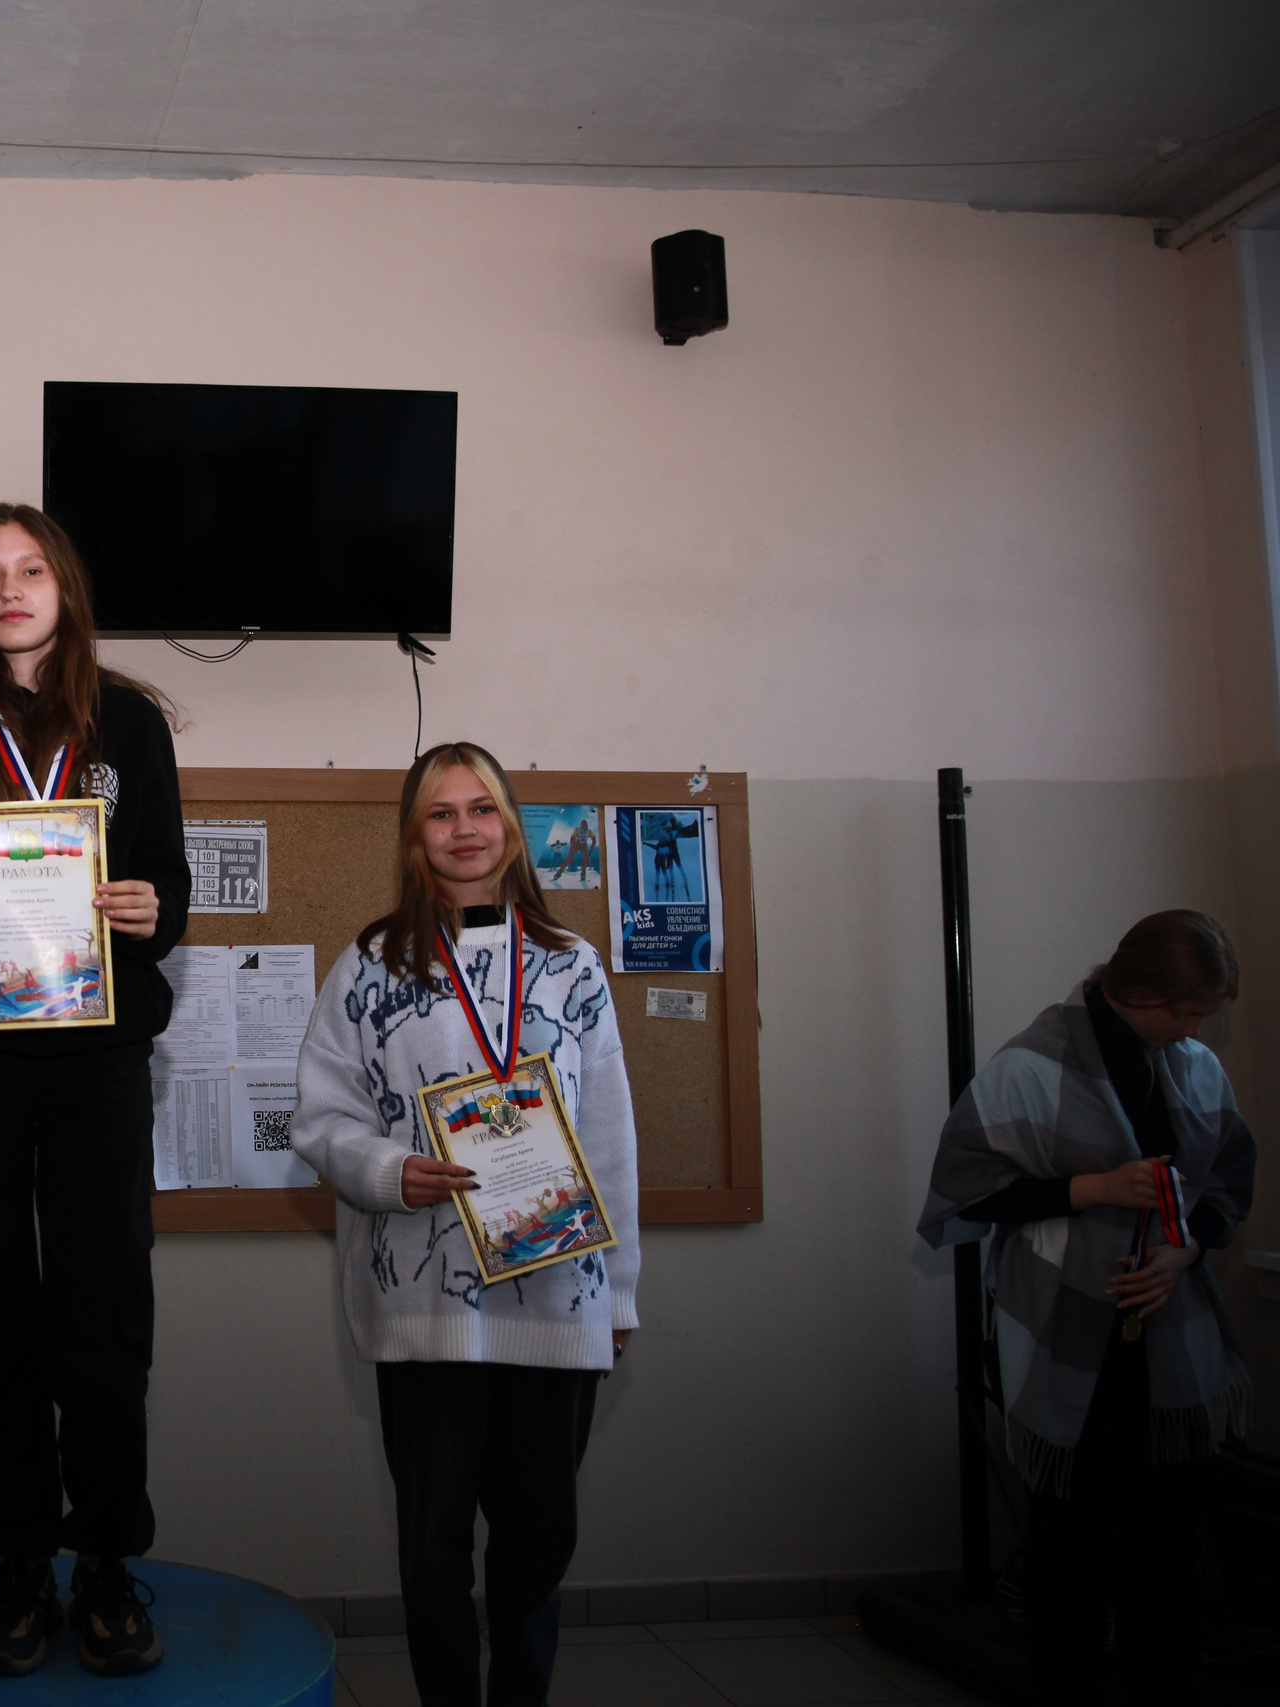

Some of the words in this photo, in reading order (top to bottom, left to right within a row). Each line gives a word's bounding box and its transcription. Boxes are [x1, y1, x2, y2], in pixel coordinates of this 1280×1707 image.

[202, 852, 215, 861] 101
[202, 866, 216, 874] 102
[202, 880, 215, 888] 103
[222, 878, 256, 905] 112
[202, 894, 215, 902] 104
[666, 907, 706, 915] СОВМЕСТНОЕ
[623, 908, 652, 925] AKS
[667, 916, 701, 924] УВЛЕЧЕНИЕ
[637, 921, 655, 930] kids
[668, 924, 709, 933] ОБЪЕДИНЯЕТ!
[472, 1120, 531, 1144] ГРАА
